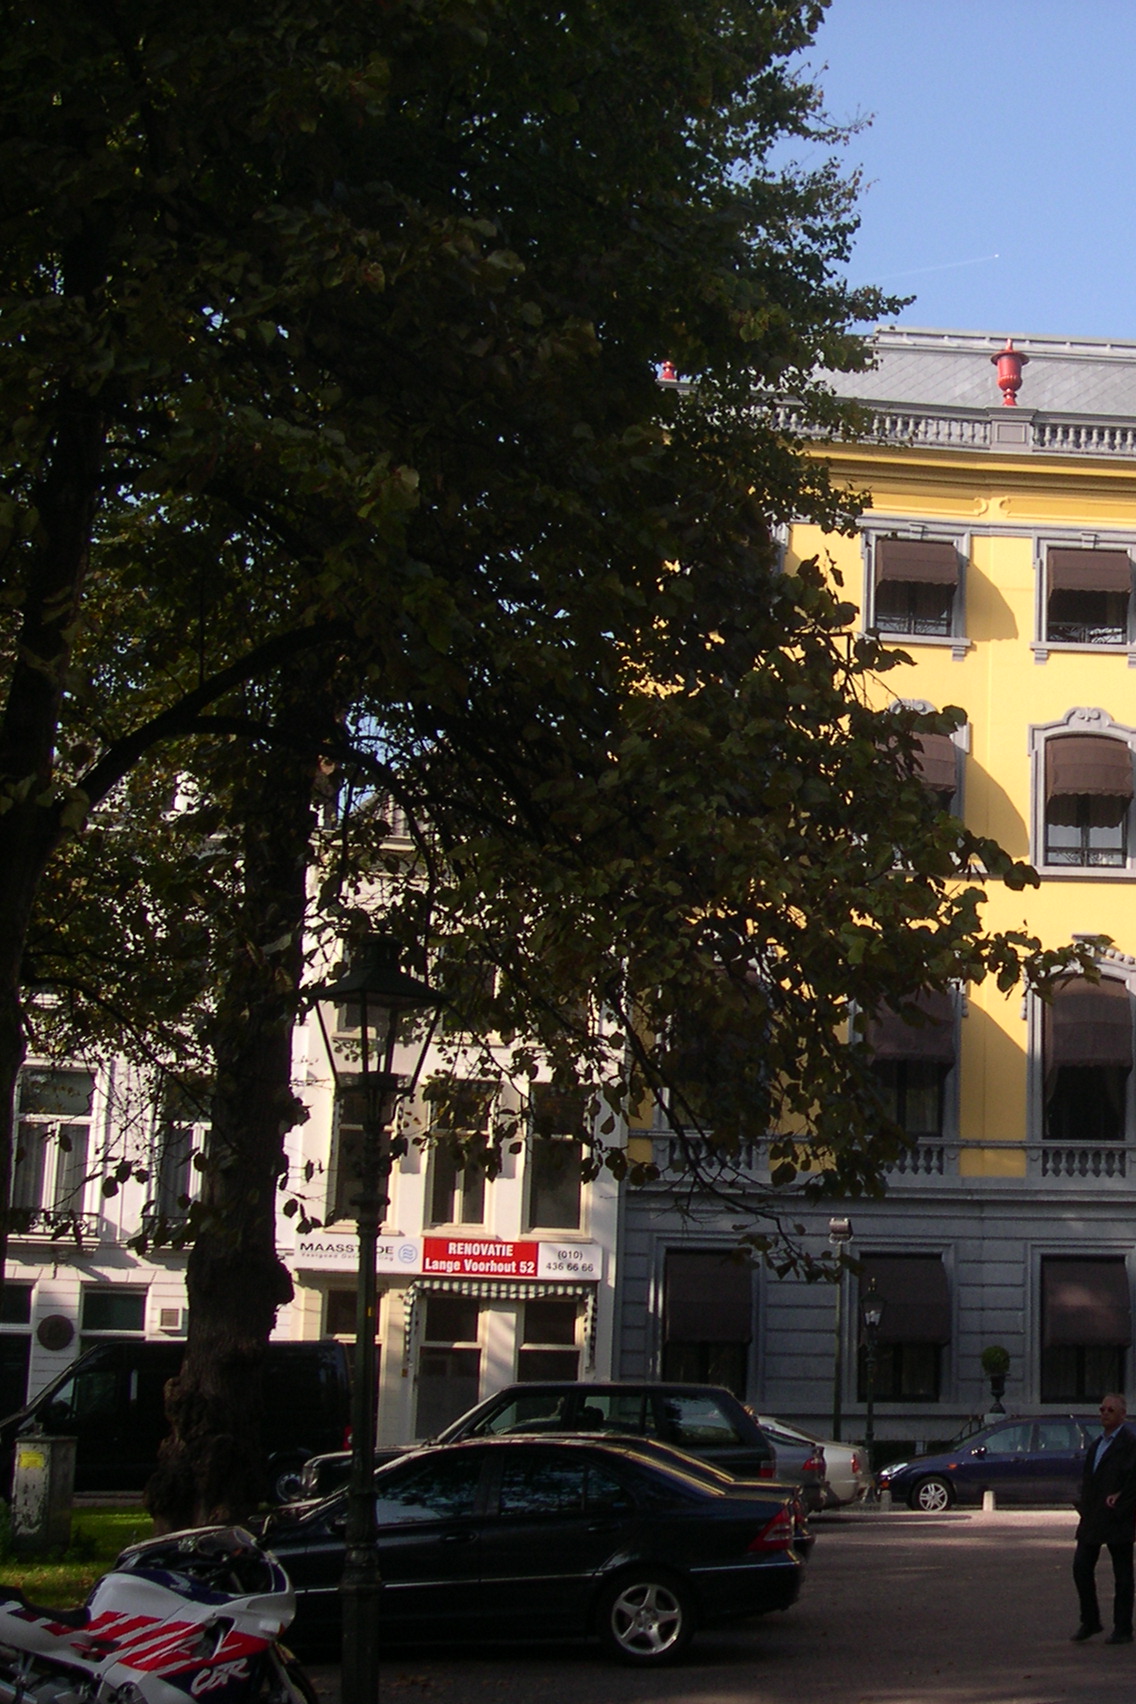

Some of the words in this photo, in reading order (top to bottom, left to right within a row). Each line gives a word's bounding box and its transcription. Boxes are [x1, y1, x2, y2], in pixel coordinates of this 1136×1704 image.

[300, 1242, 394, 1255] MAASSTDE
[448, 1242, 513, 1257] RENOVATIE
[557, 1249, 583, 1261] (010)
[425, 1258, 461, 1273] Lange
[464, 1258, 516, 1273] Voorhout
[519, 1261, 535, 1274] 52
[546, 1262, 564, 1272] 436
[566, 1262, 579, 1272] 66
[580, 1263, 594, 1273] 66
